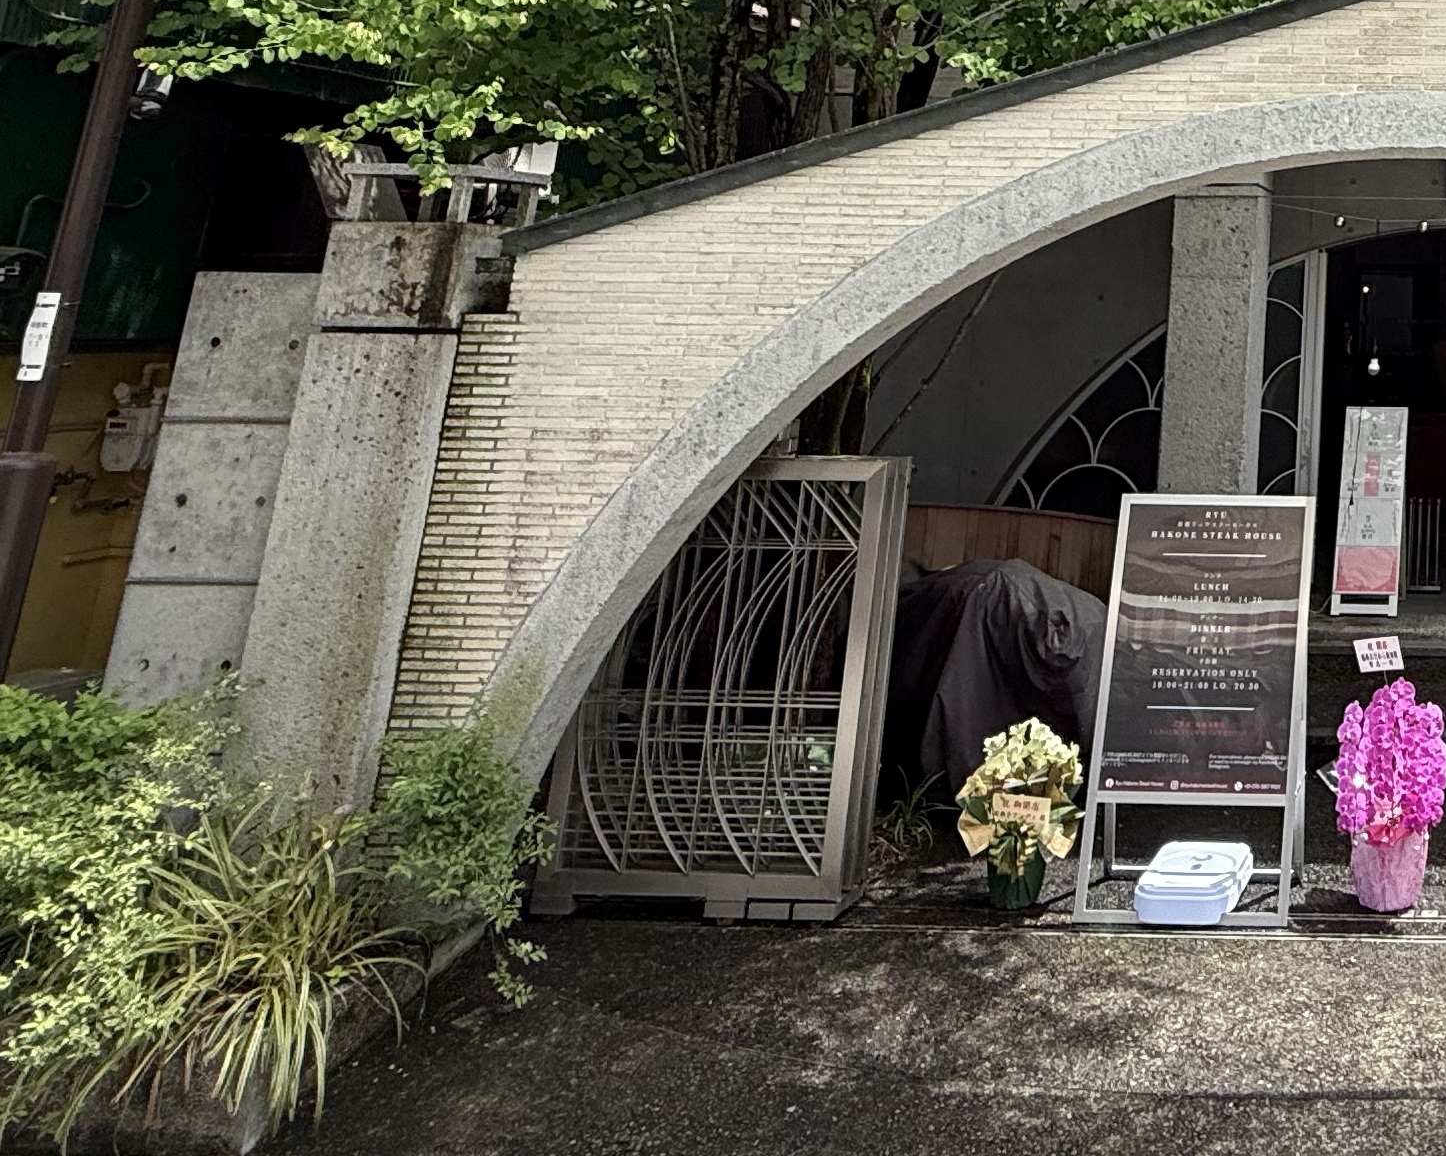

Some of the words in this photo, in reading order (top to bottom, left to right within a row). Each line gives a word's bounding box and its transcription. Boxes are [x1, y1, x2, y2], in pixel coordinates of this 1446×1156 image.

[1205, 511, 1228, 519] RYU
[1151, 530, 1197, 539] HAKONE
[1202, 531, 1239, 540] STEAK
[1244, 532, 1282, 540] HOUSE
[1194, 583, 1229, 591] LUNCH
[1190, 624, 1231, 633] DINNER
[1152, 668, 1226, 677] RESERVATION
[1230, 669, 1257, 678] ONLY
